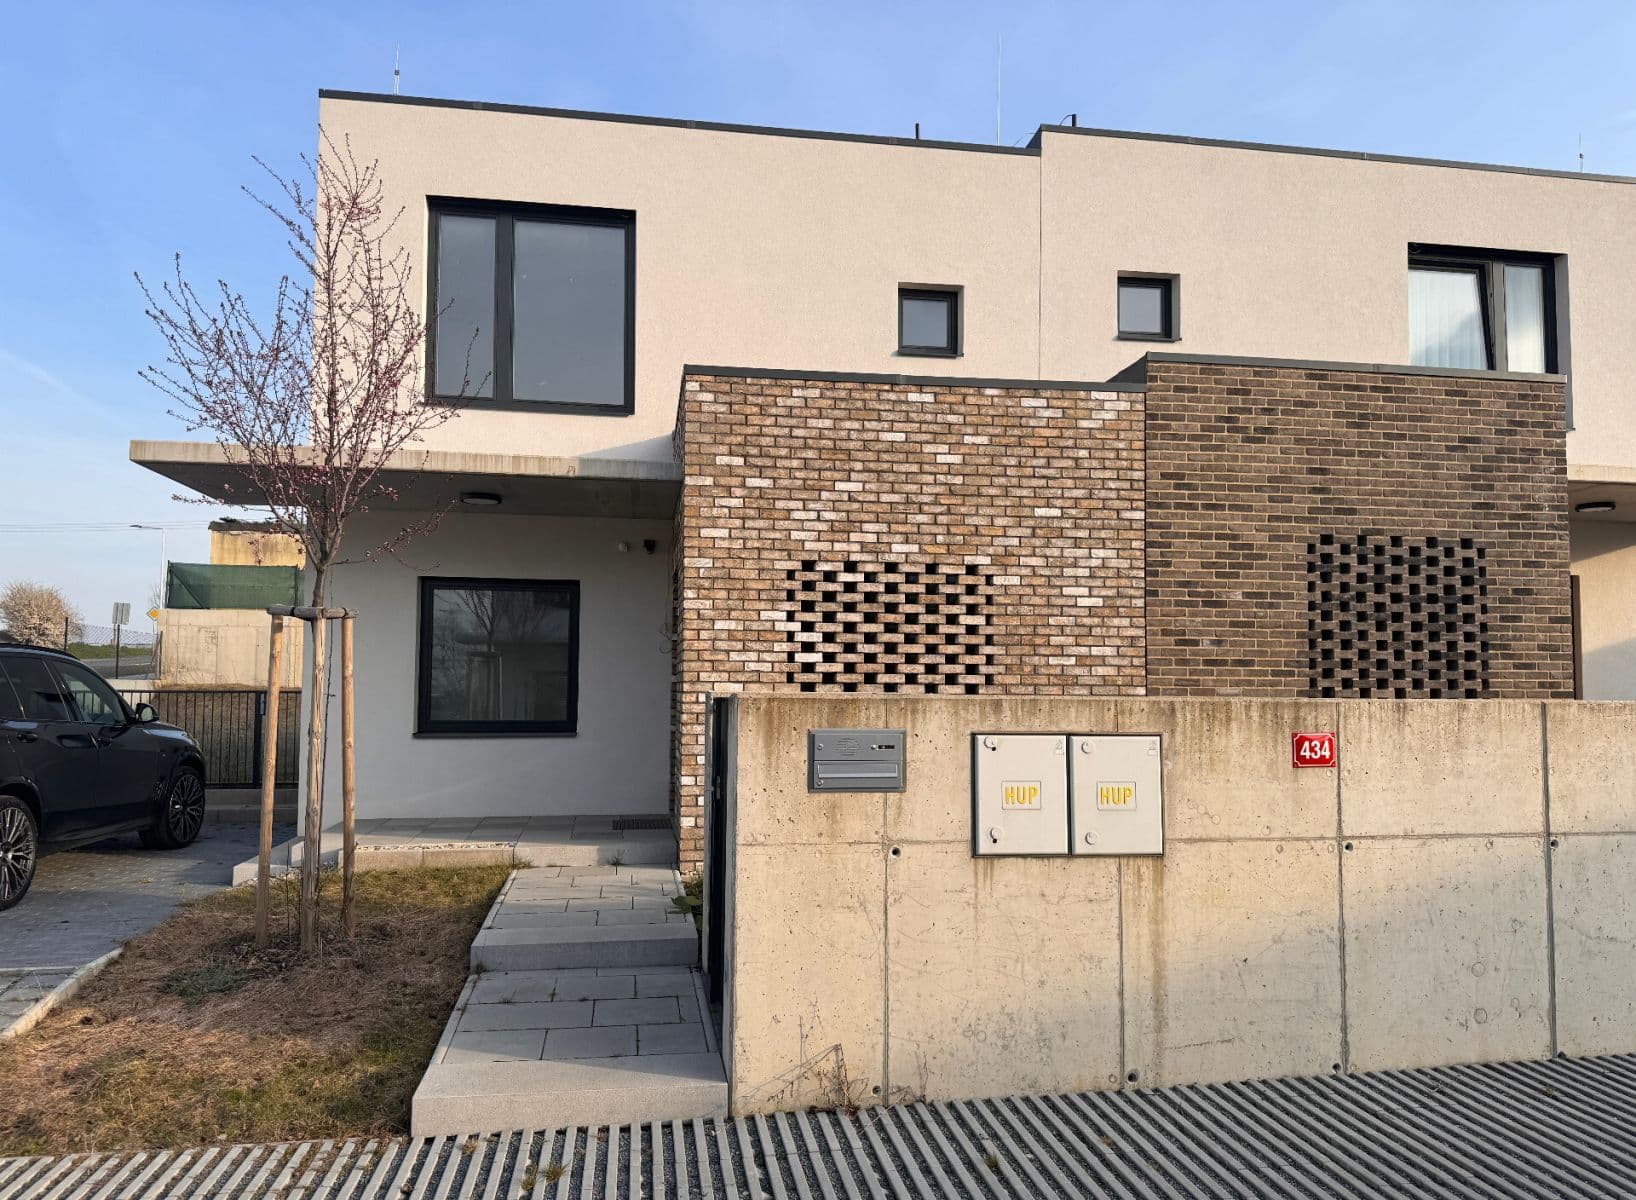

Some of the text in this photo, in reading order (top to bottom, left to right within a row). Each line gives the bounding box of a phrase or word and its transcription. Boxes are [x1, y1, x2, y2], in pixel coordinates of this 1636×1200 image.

[1300, 740, 1331, 760] 434
[1004, 785, 1039, 805] HUP
[1100, 785, 1134, 805] HUP
